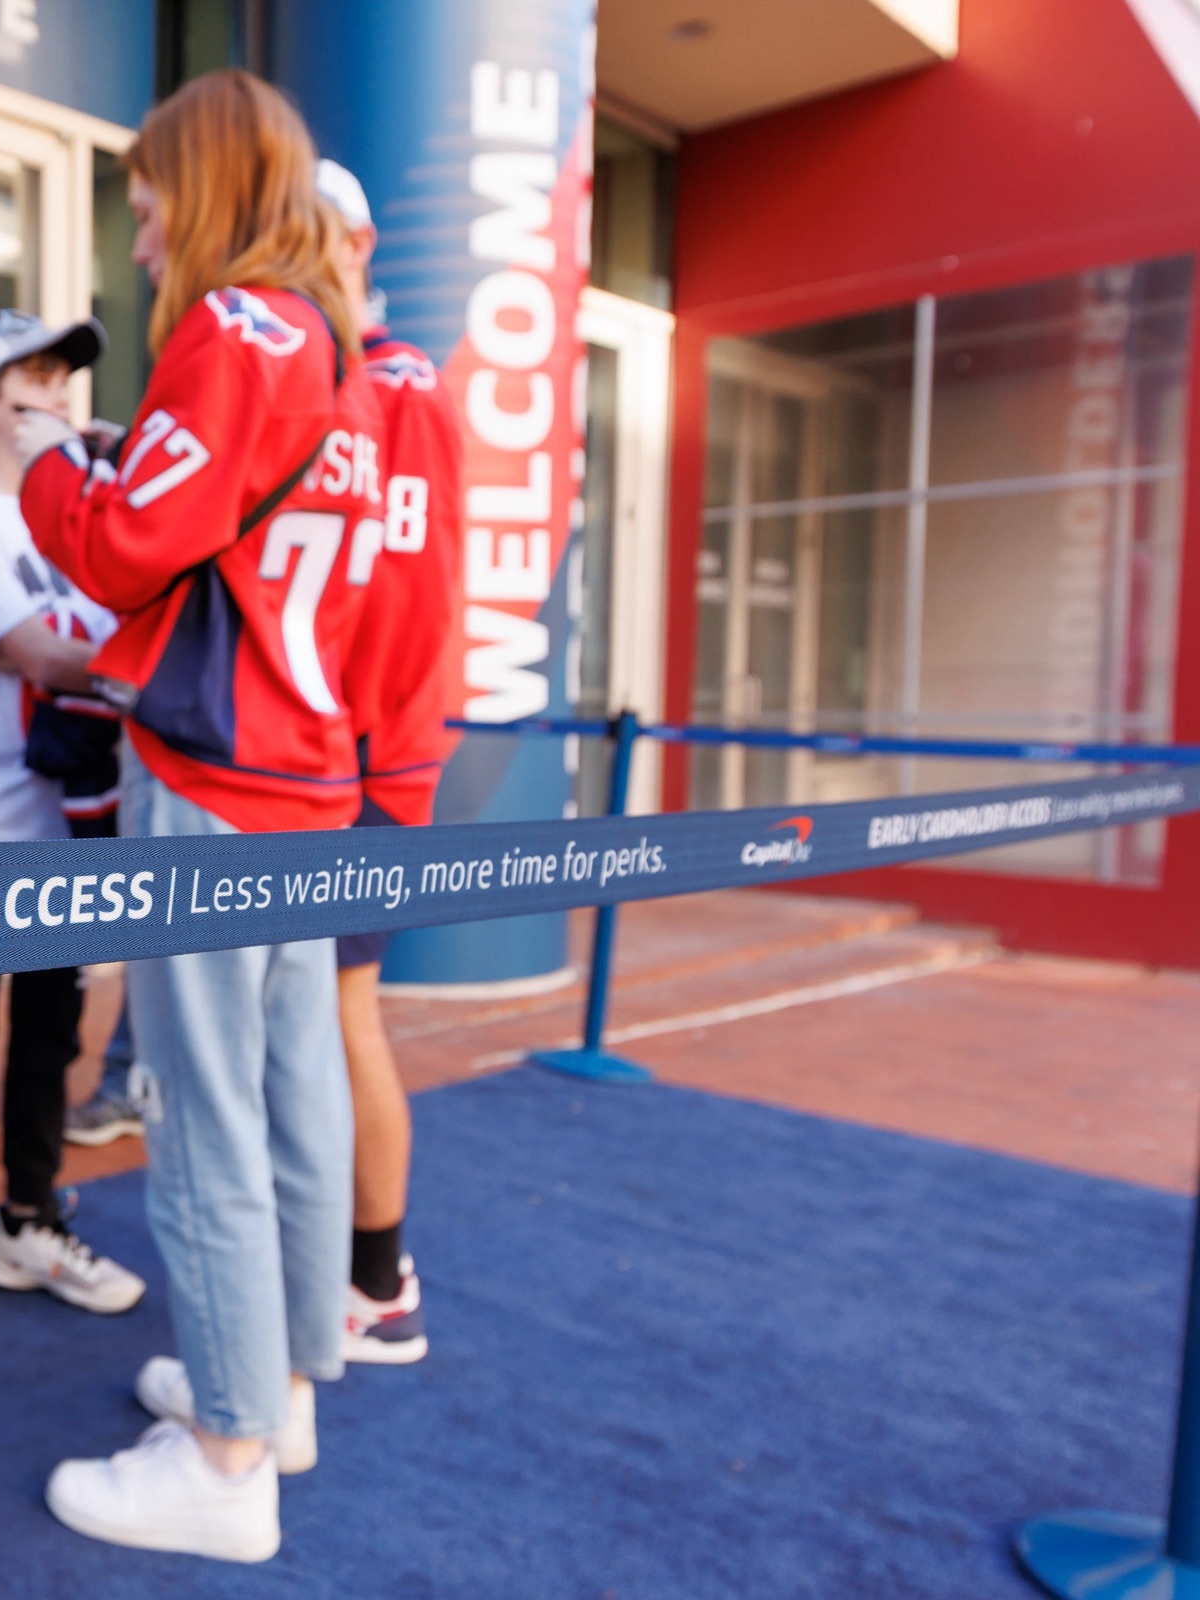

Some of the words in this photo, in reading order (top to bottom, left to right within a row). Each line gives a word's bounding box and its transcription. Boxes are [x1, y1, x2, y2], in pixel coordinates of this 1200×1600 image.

[464, 60, 559, 724] WELCOME
[118, 408, 211, 510] 77
[385, 474, 429, 554] 8
[866, 813, 918, 849] EARLY
[917, 801, 1008, 843] CARDHOLDER
[1007, 796, 1052, 828] ACCESS
[190, 869, 272, 914] Less
[283, 857, 411, 910] waiting,
[420, 857, 493, 894] more
[500, 847, 557, 888] time
[562, 840, 598, 883] for
[600, 836, 667, 887] perks.
